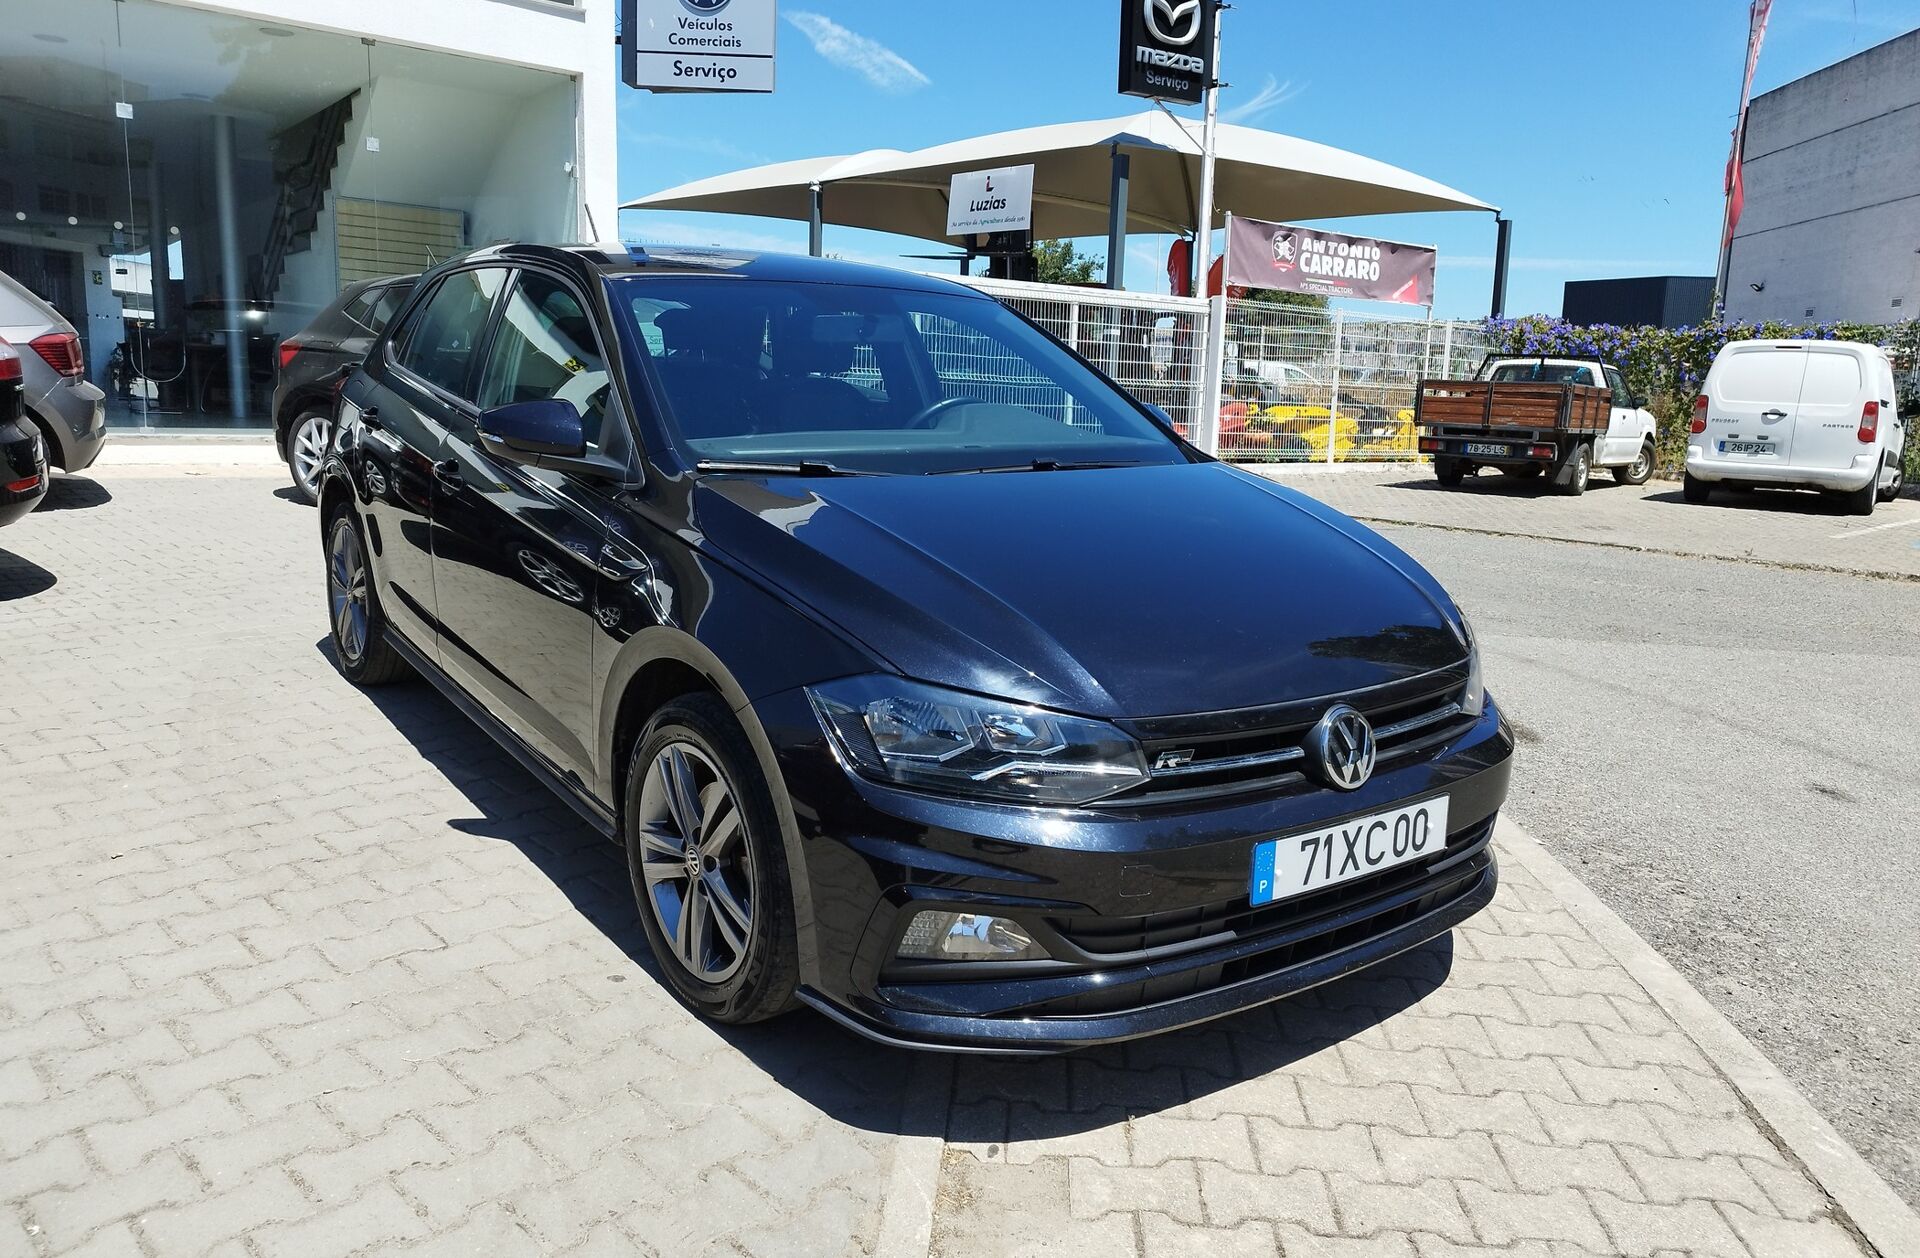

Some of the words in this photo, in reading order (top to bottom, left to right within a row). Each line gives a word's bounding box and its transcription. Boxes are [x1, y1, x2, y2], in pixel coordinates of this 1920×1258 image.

[677, 17, 733, 31] Veículos
[668, 33, 742, 48] Comerciais
[673, 60, 737, 83] Serviço
[1145, 70, 1189, 91] Serviço
[969, 195, 1007, 213] Luzias
[1301, 237, 1381, 261] ANTONIO
[1299, 252, 1380, 282] CARRARO
[1309, 283, 1328, 293] SPECIAL
